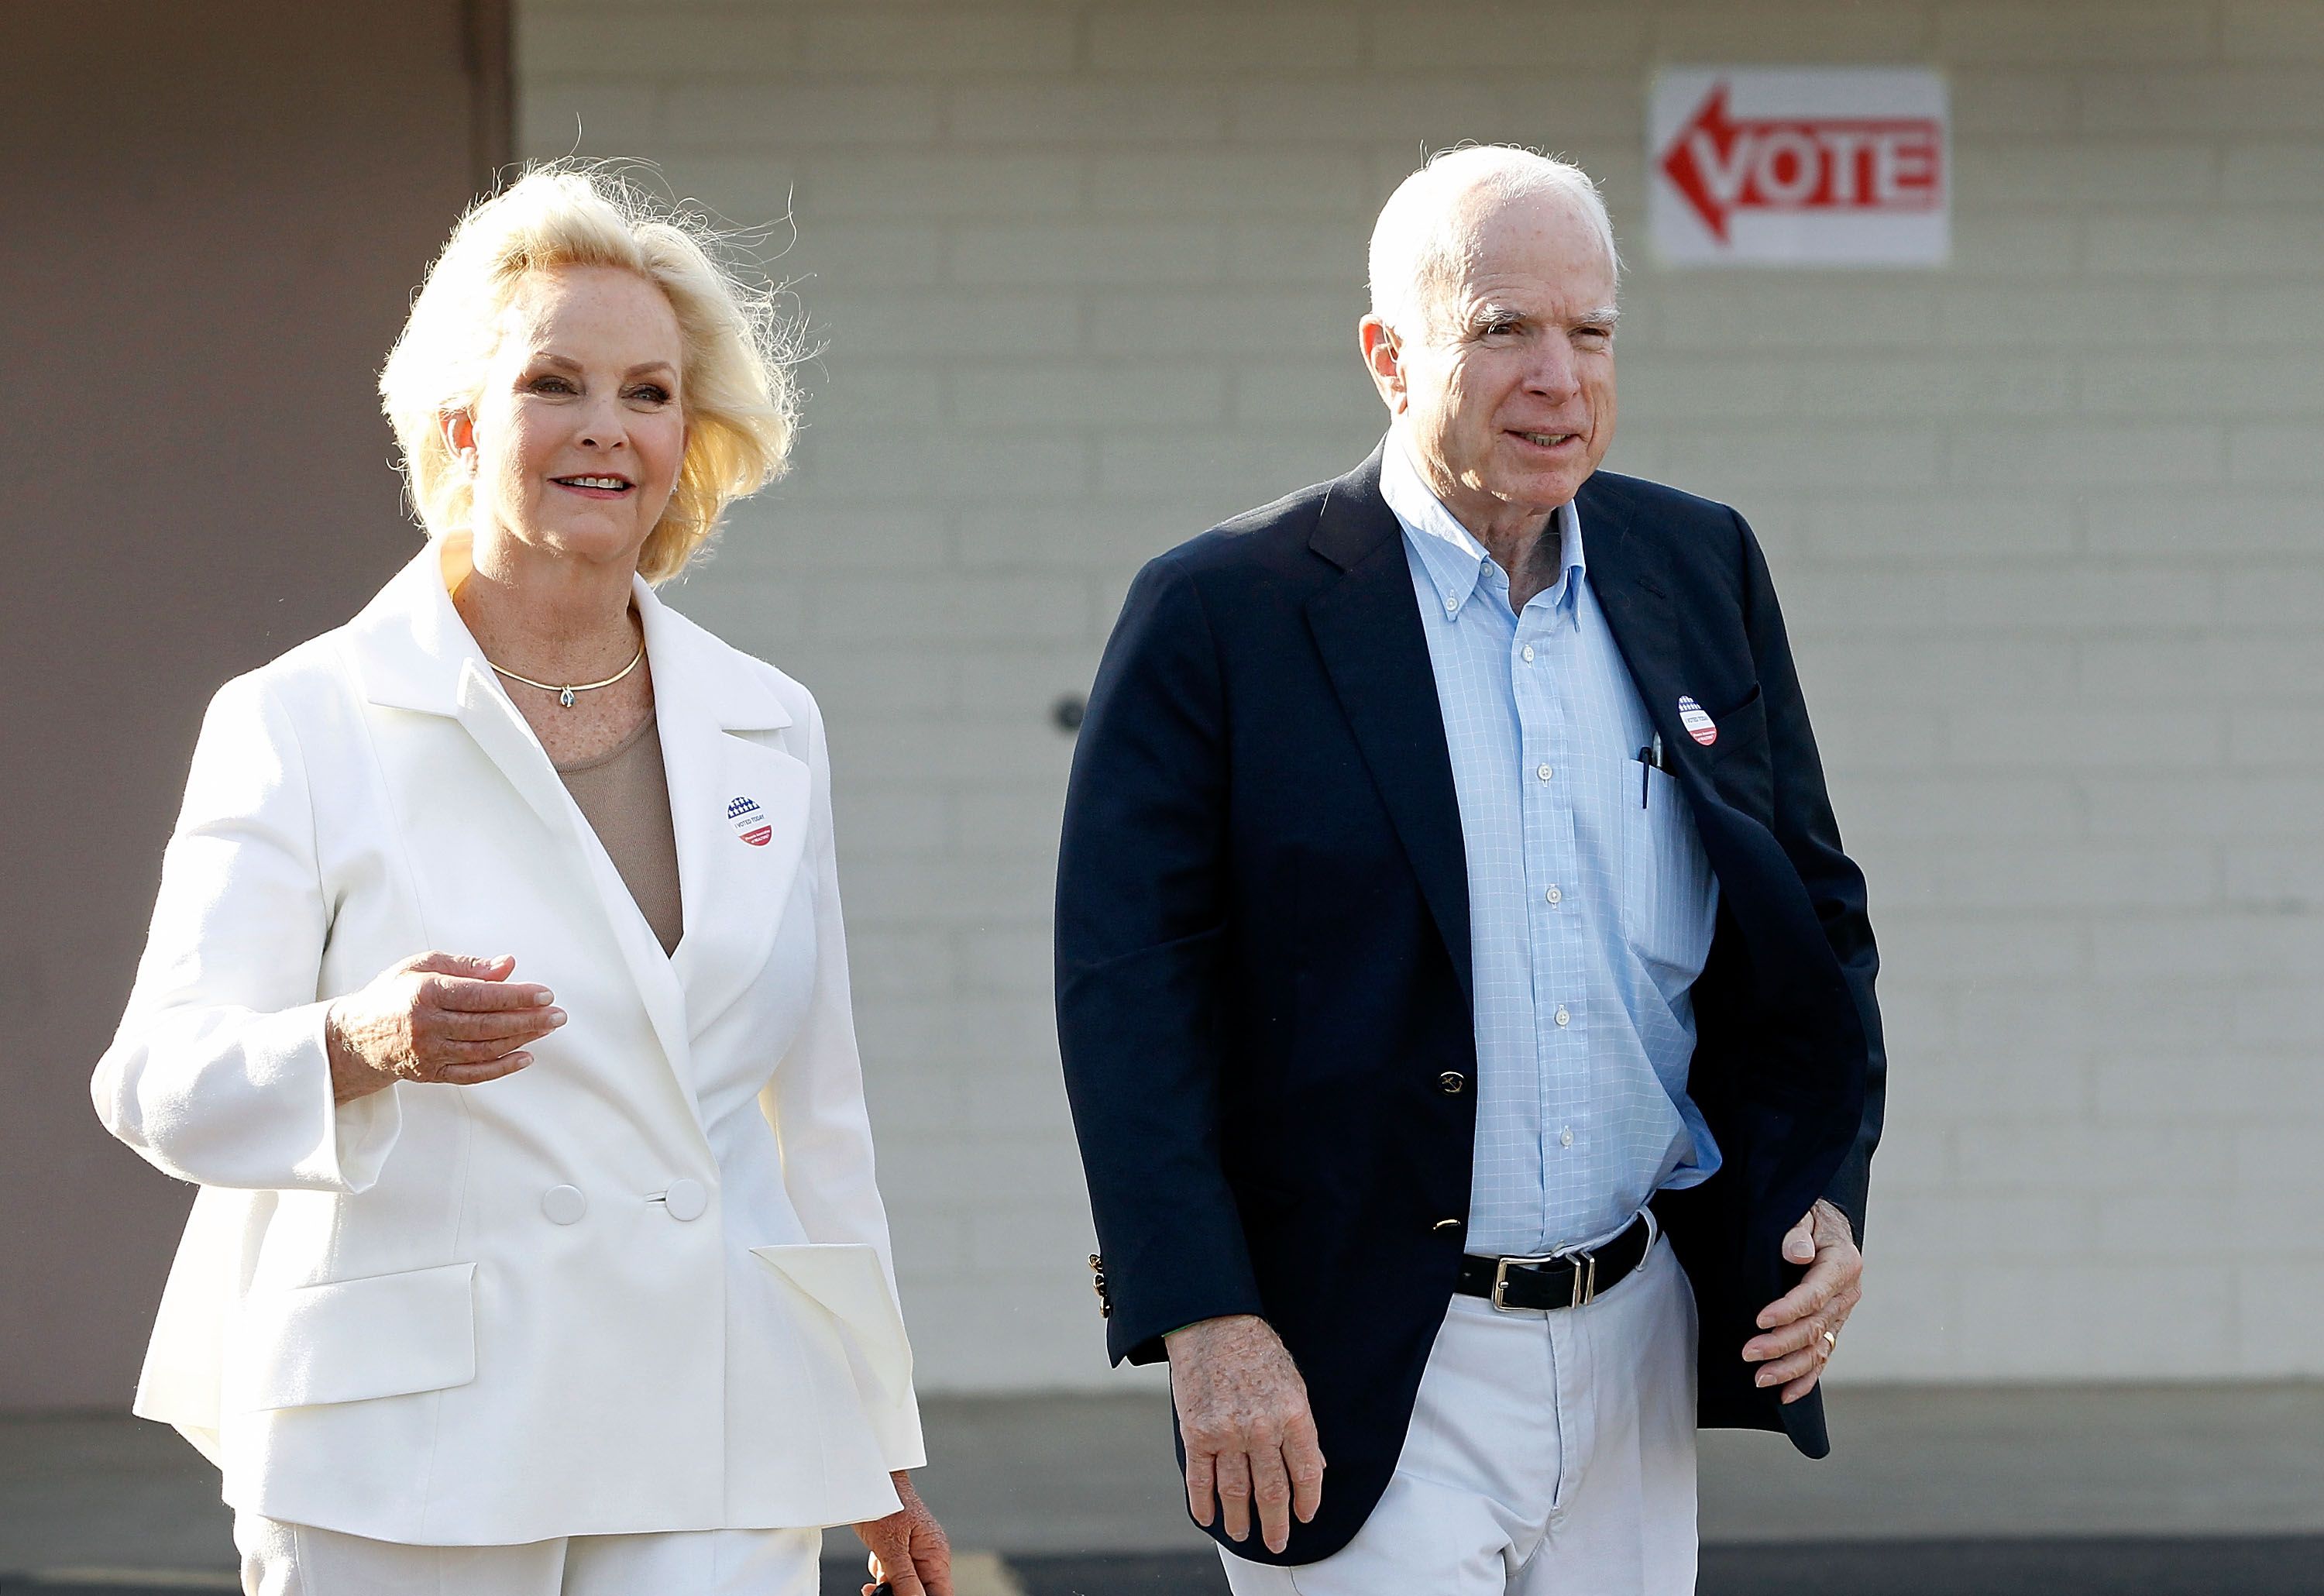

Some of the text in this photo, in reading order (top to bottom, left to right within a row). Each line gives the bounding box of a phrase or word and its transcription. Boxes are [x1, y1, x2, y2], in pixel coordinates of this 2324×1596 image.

[1689, 130, 1934, 201] VOTE
[736, 819, 751, 828] VOTED
[751, 814, 765, 823] TODAY
